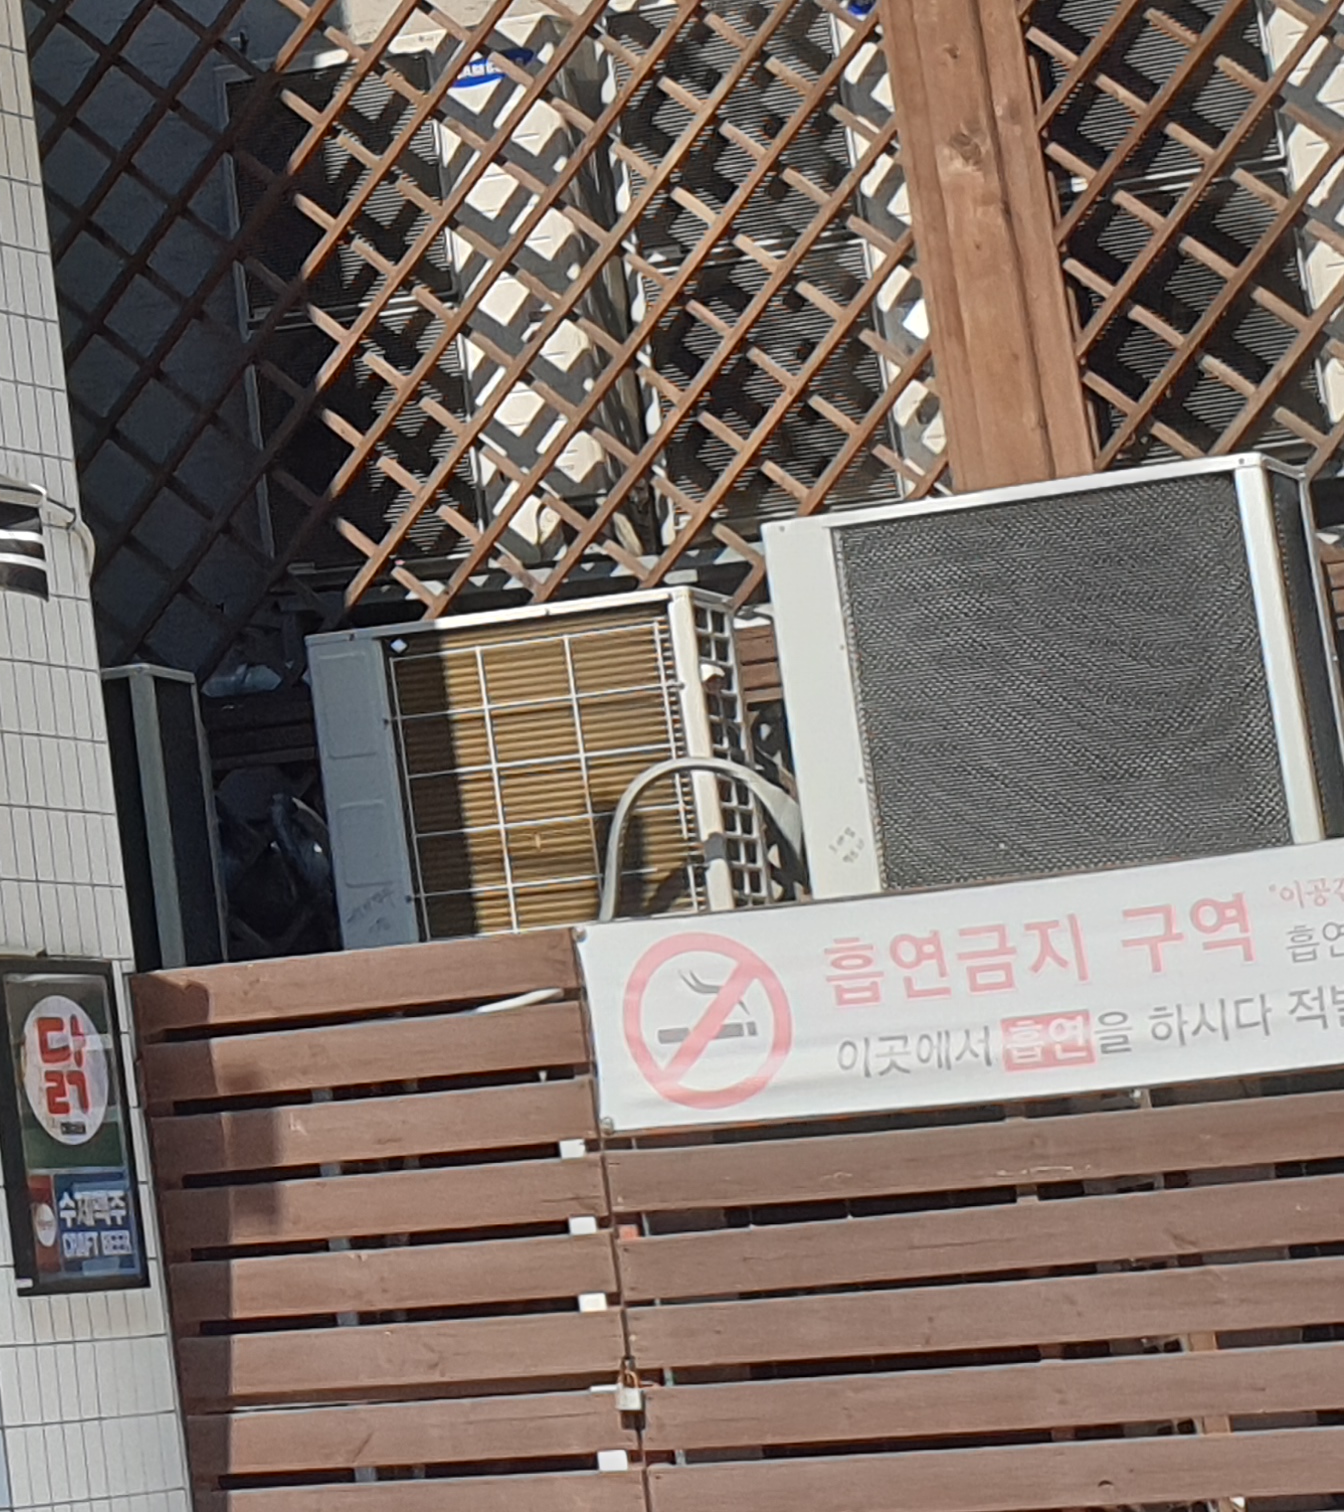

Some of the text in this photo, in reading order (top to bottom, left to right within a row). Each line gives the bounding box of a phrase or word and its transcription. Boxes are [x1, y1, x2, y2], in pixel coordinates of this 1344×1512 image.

[823, 912, 1089, 1009] 흡연금지
[1121, 891, 1257, 974] 구역
[36, 1014, 90, 1116] 닭
[836, 1020, 992, 1079] 이곳에서
[1005, 1010, 1133, 1062] 흡연을
[1148, 993, 1273, 1047] 하시다
